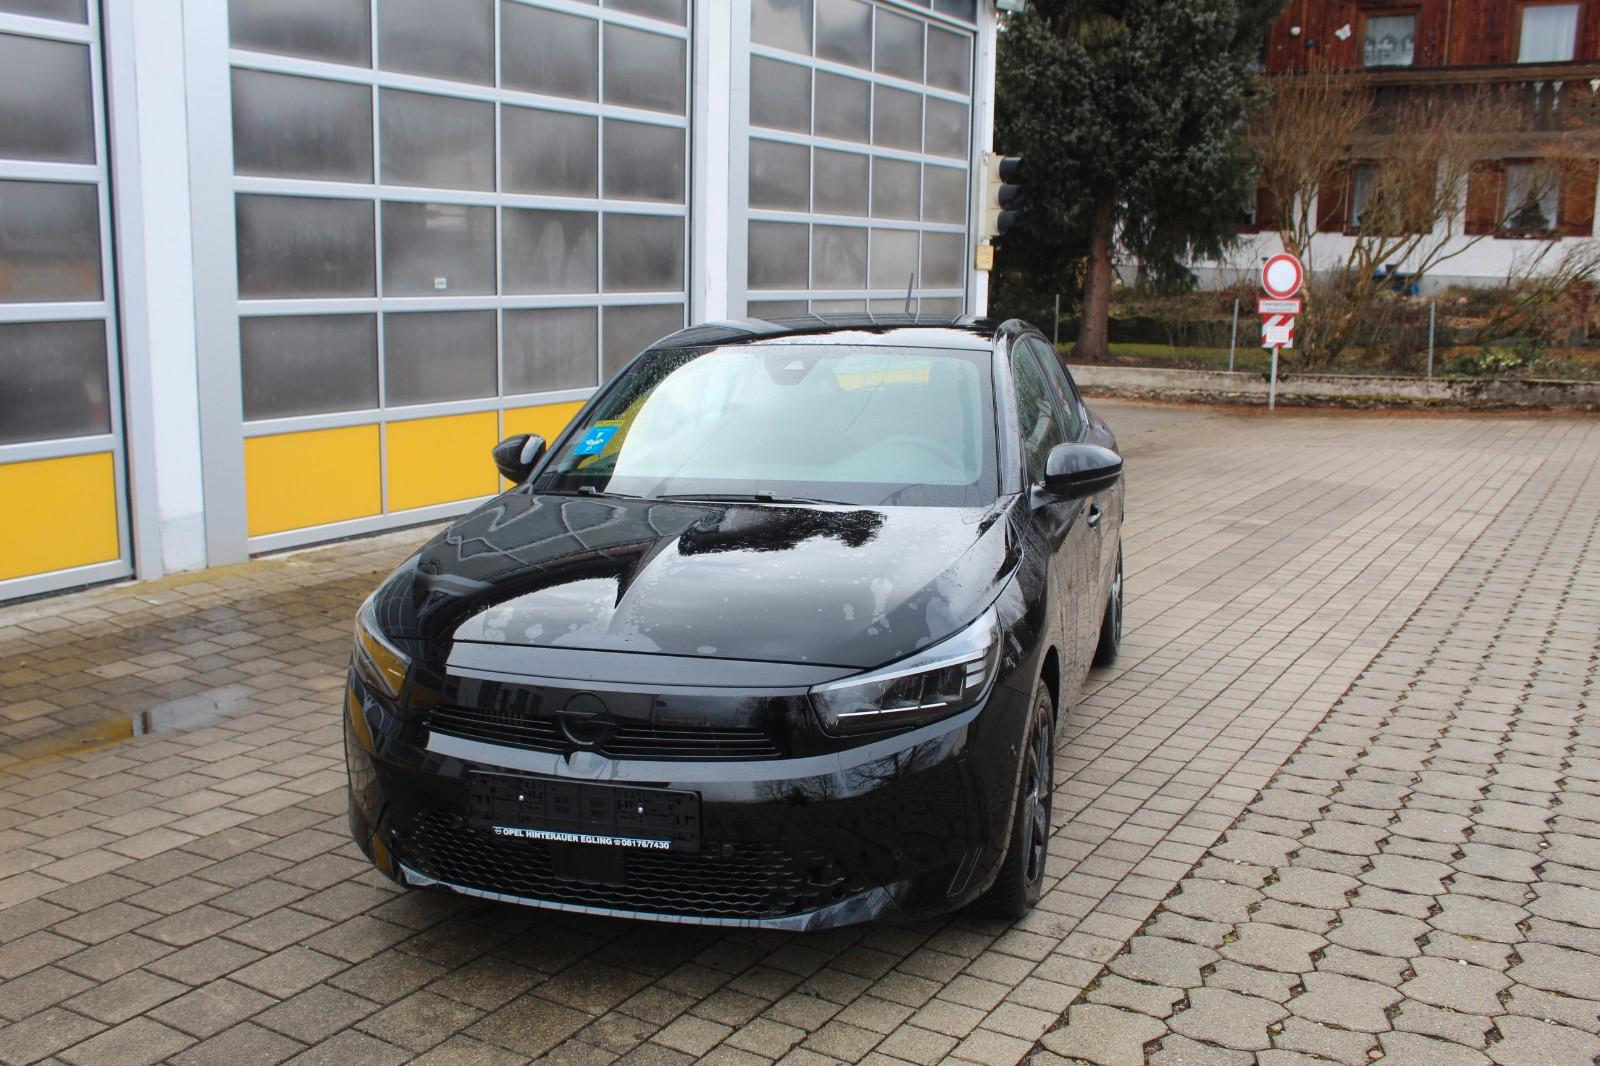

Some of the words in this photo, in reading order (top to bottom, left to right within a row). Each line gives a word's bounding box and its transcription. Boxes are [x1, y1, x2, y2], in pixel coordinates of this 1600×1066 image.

[503, 828, 524, 837] OPEL
[526, 831, 578, 842] HINTERAUER
[581, 835, 612, 846] EGLING
